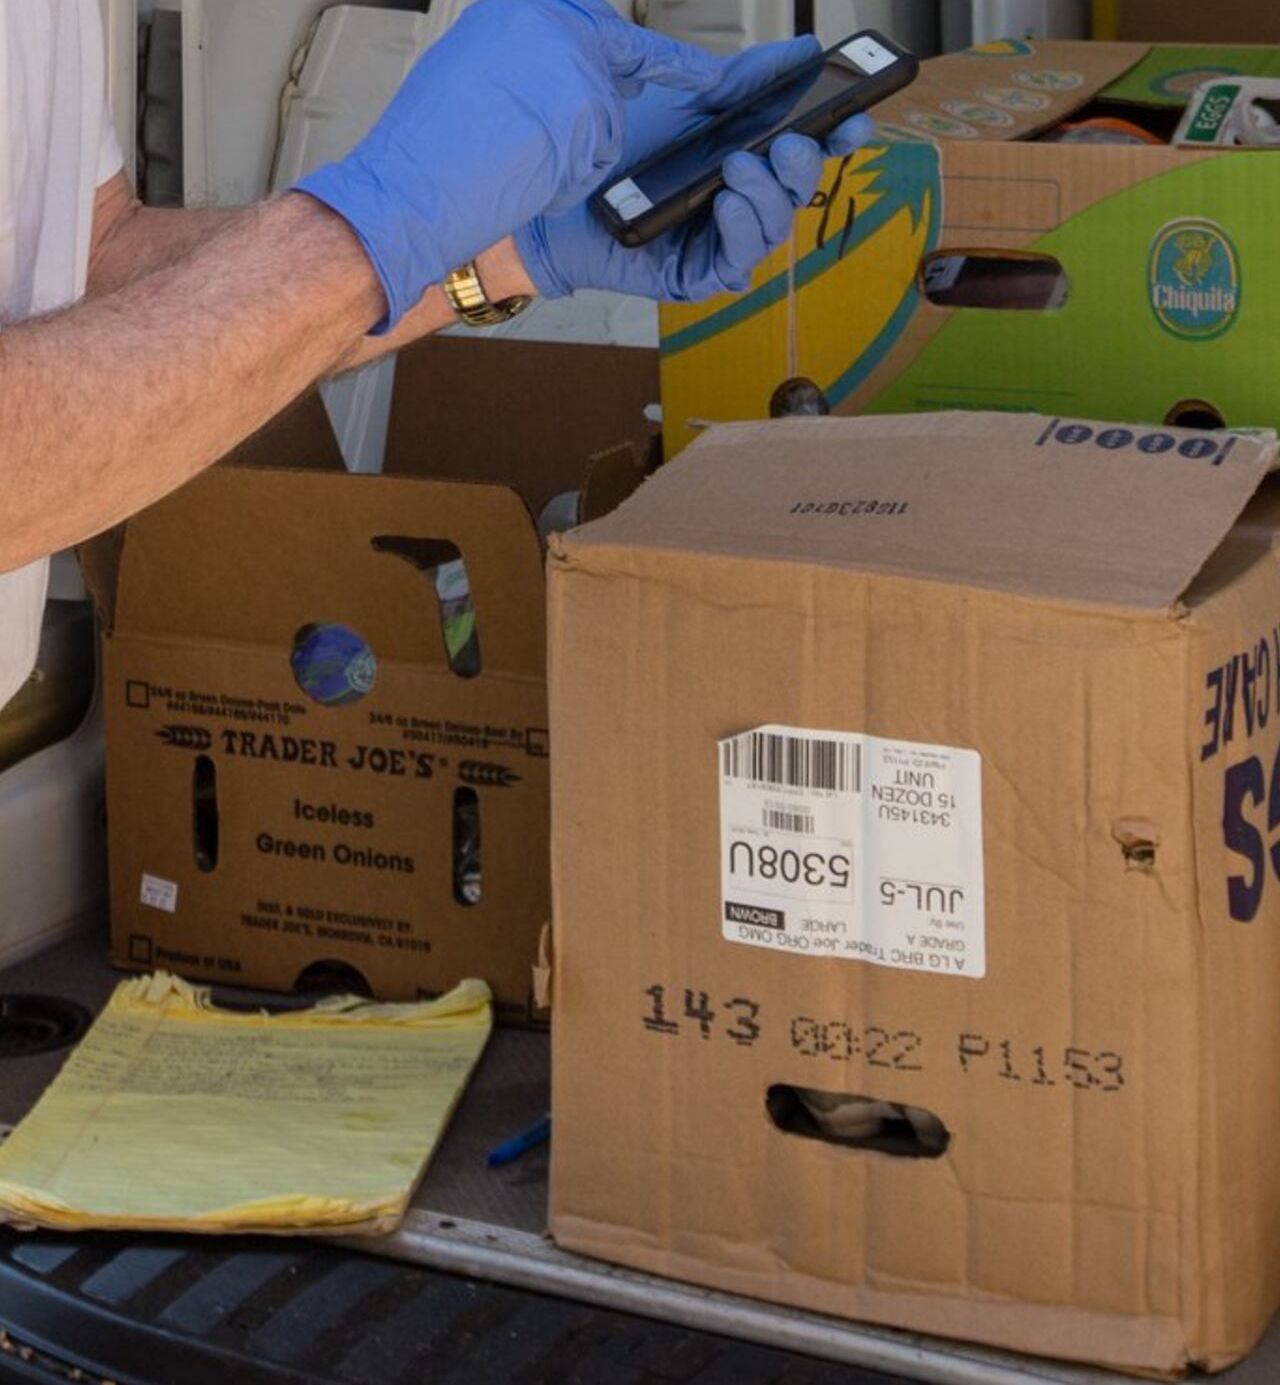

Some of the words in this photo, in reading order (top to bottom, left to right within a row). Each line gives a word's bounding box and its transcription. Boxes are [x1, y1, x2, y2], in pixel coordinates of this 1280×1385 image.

[1194, 94, 1230, 131] EGGS
[1151, 282, 1237, 316] Chiquita
[1200, 637, 1270, 762] CARE
[222, 729, 338, 768] TRADER
[348, 745, 437, 779] JOE'S
[895, 769, 934, 787] UNIT
[872, 785, 932, 806] DOZEN
[937, 793, 956, 808] 15
[295, 798, 374, 828] Iceless
[878, 805, 951, 828] 343145U
[255, 833, 326, 861] Green
[334, 843, 415, 874] Onions
[729, 841, 850, 888] 5308U
[880, 881, 964, 914] JUL-5
[730, 905, 777, 926] BROWN
[801, 919, 848, 932] LARGE
[739, 926, 773, 943] OMG
[778, 932, 810, 948] ORG
[813, 938, 839, 951] Joe
[907, 934, 915, 945] A
[921, 937, 966, 952] GRADE
[845, 940, 885, 960] Trader
[891, 950, 924, 965] BRC
[929, 955, 951, 969] LG
[955, 958, 965, 970] A
[643, 984, 760, 1046] 143
[958, 1032, 1125, 1091] P1153
